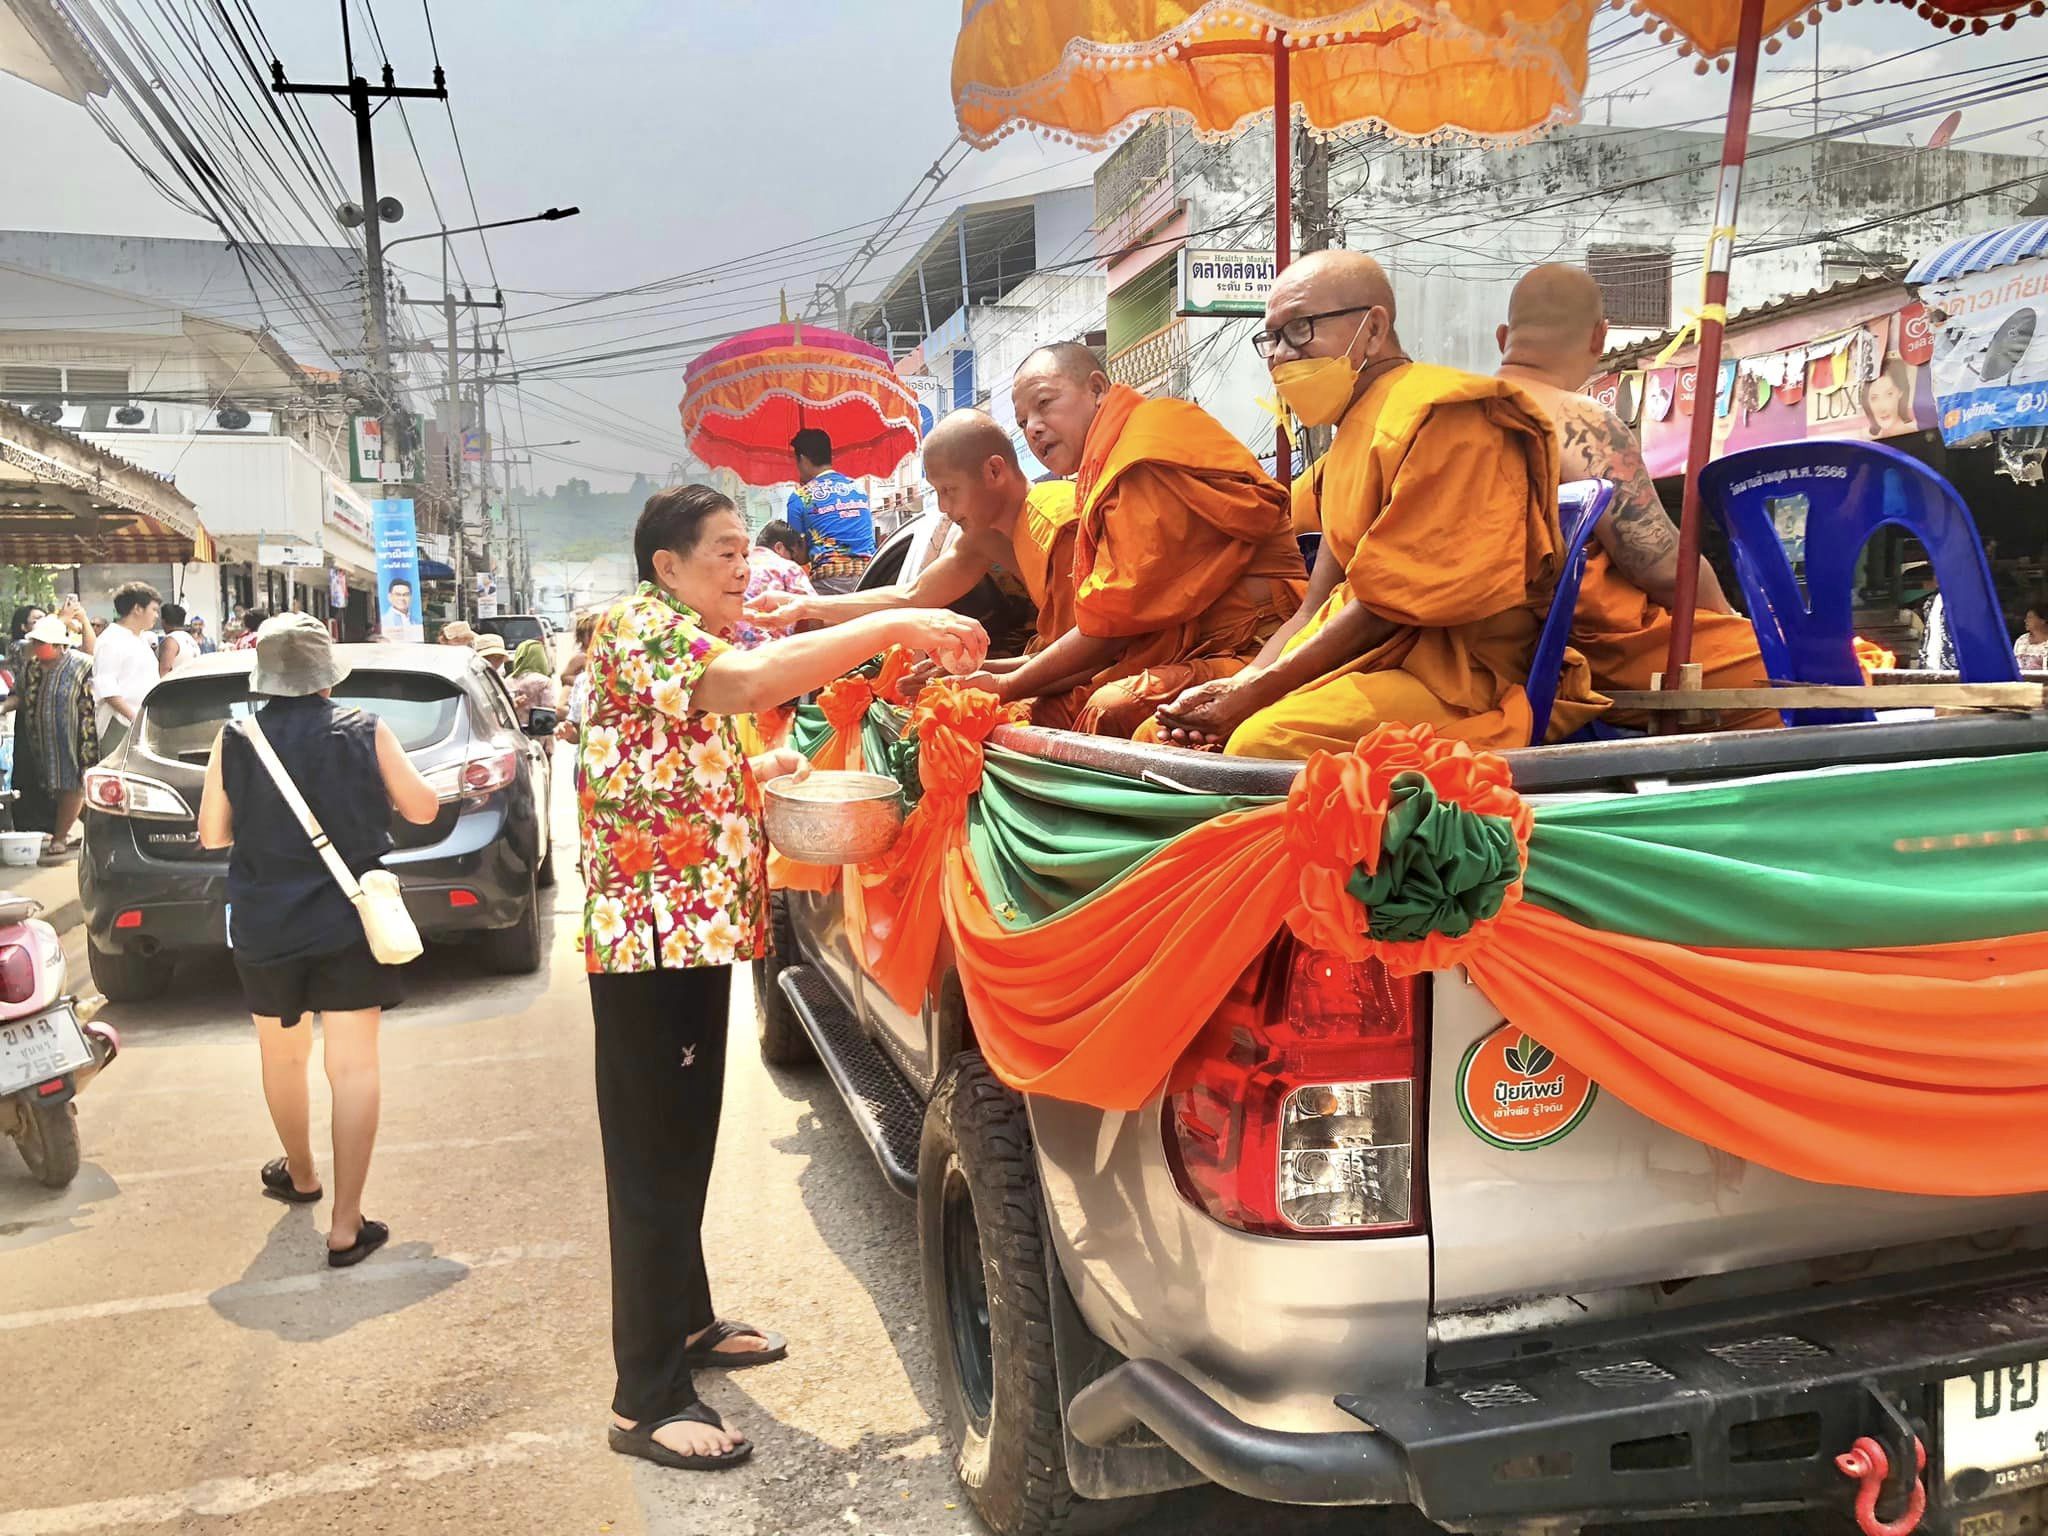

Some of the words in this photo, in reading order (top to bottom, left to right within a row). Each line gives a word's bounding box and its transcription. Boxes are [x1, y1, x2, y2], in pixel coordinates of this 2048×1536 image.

[1214, 254, 1244, 263] Healthy
[1246, 254, 1273, 263] Market
[1192, 262, 1275, 279] ตลาดสดน่า
[1216, 281, 1241, 292] ระดับ
[1244, 281, 1254, 292] 5
[1938, 271, 2048, 317] ดาวเทีย
[1815, 384, 1858, 422] LUX
[1789, 465, 1813, 480] พ.ศ.
[1814, 464, 1848, 479] 2566
[1494, 1075, 1565, 1107] ปุ๋ยทิพย์
[1493, 1105, 1530, 1119] เข้าใจพืช
[1533, 1103, 1564, 1117] รู้ใจดิน
